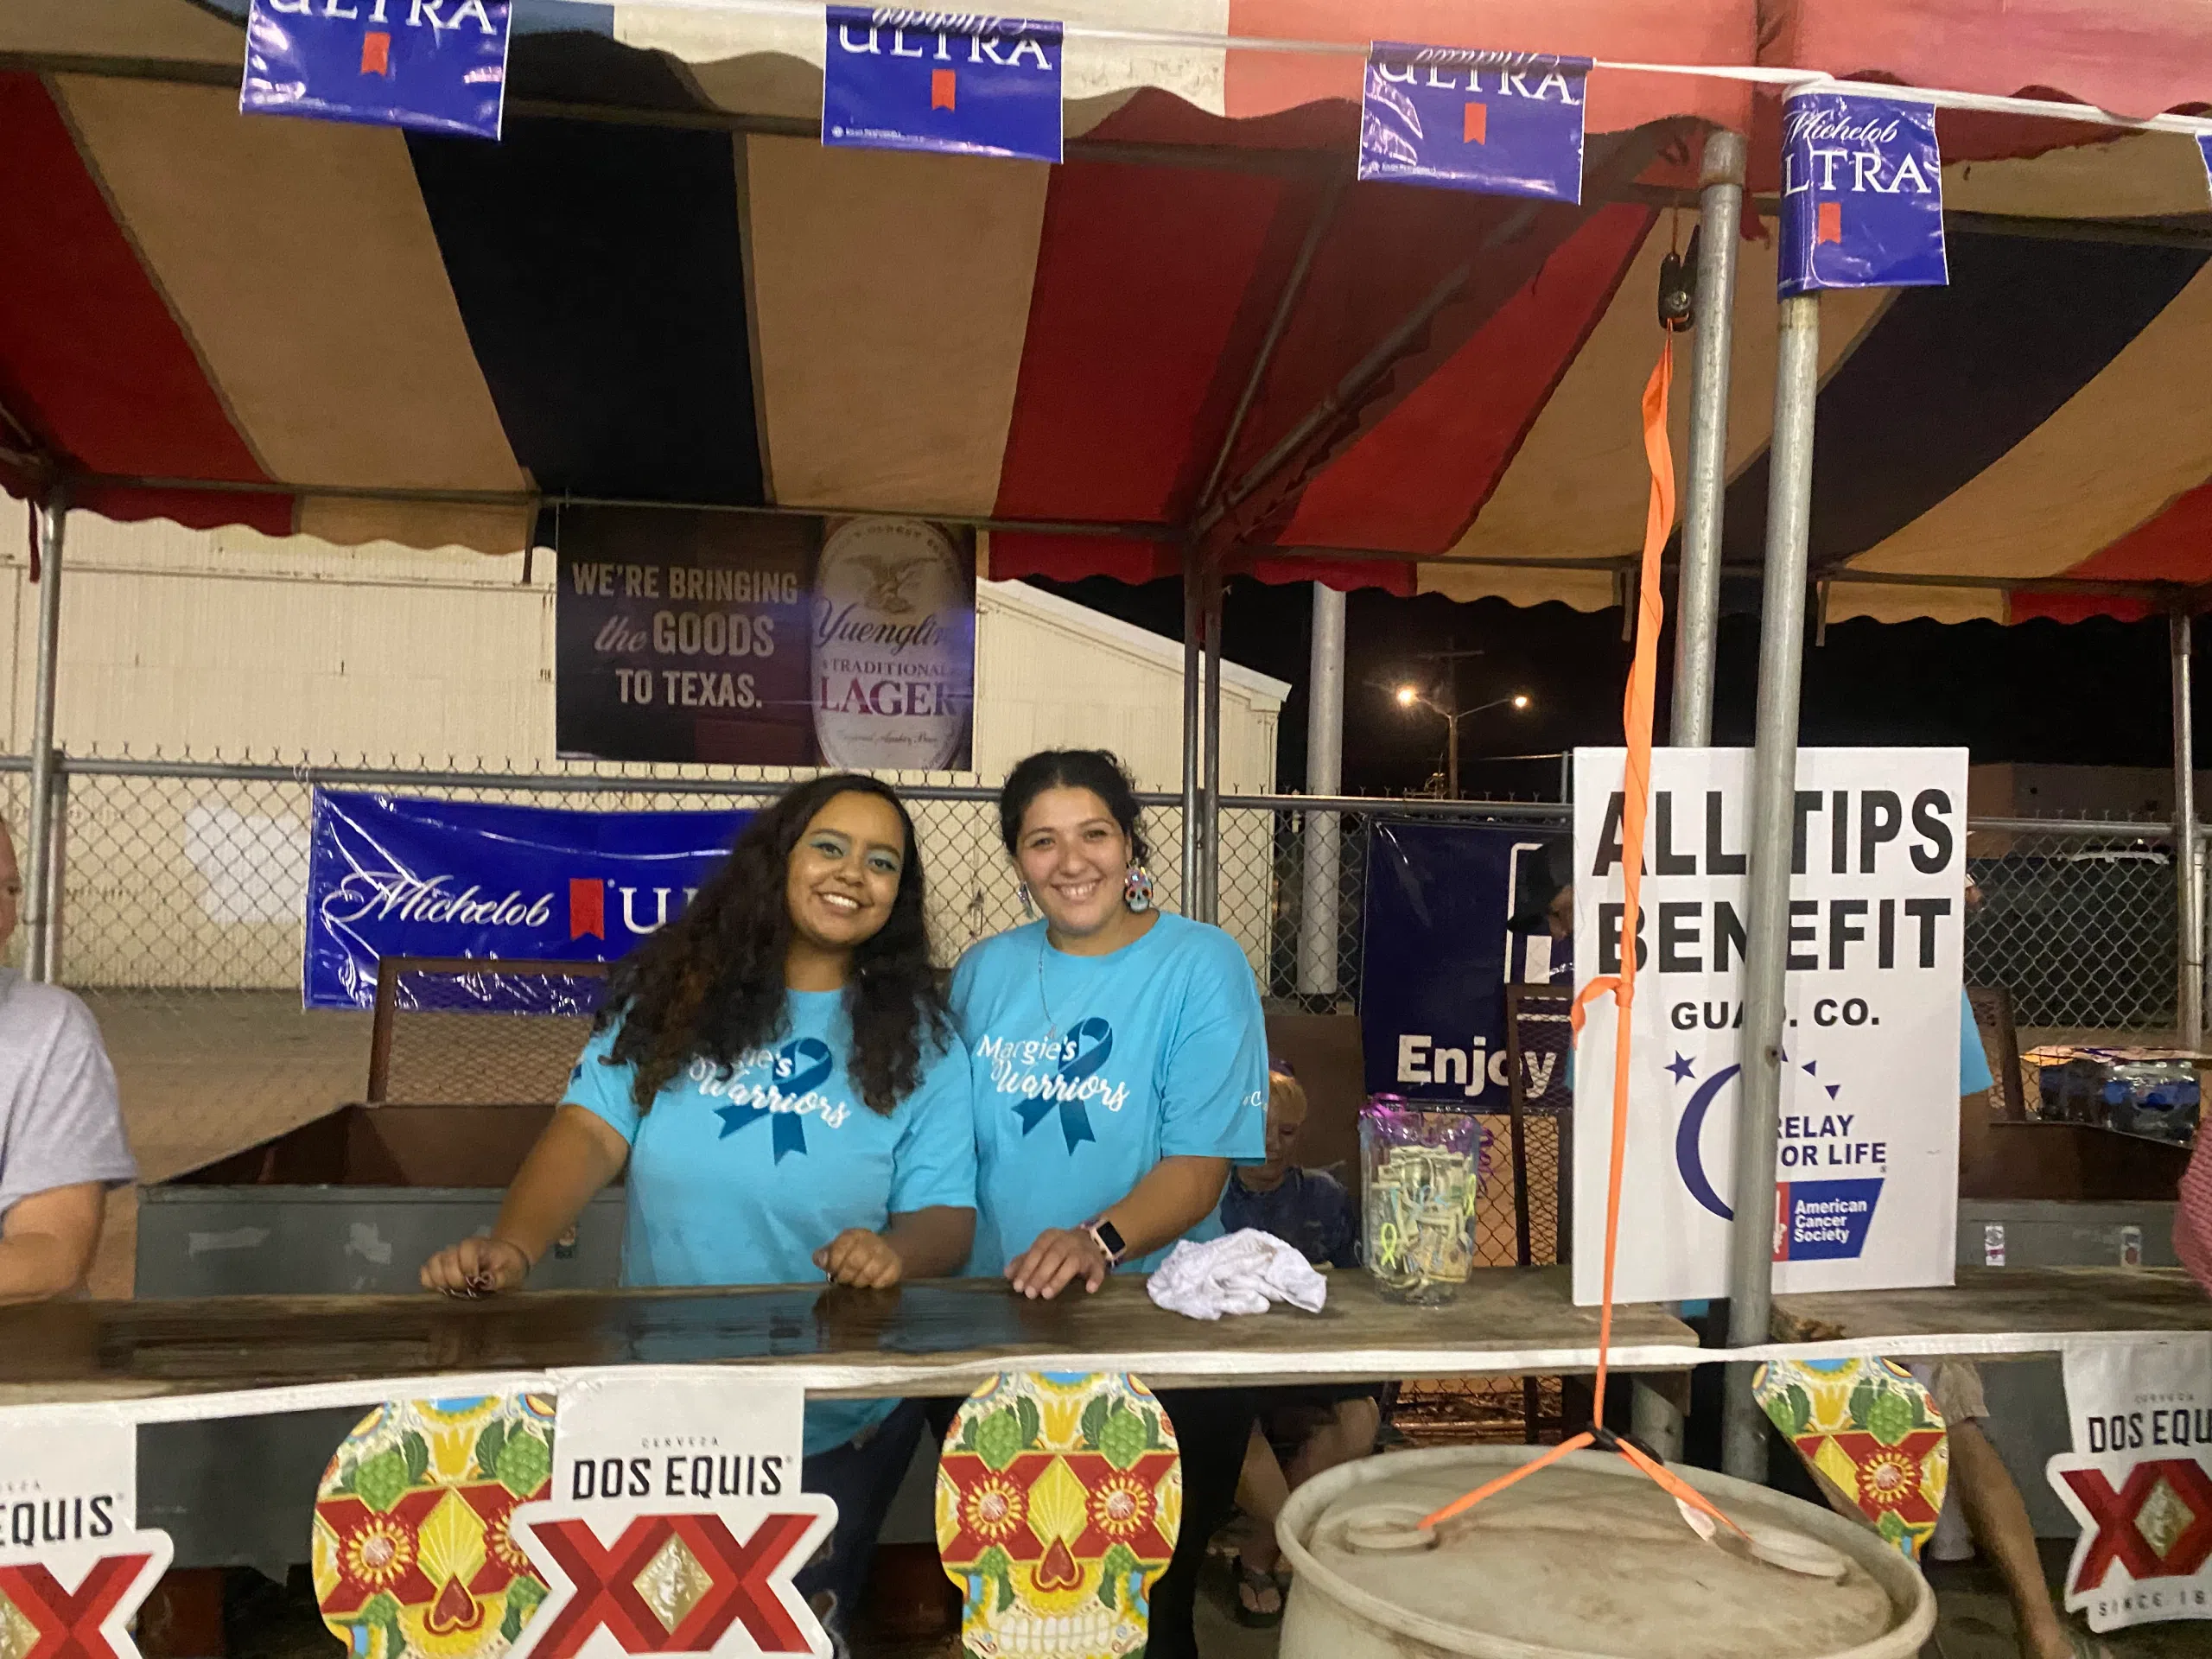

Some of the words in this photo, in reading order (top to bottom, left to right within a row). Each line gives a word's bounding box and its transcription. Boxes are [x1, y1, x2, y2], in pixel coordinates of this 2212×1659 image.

[1783, 108, 1901, 147] Michelob
[571, 562, 660, 599] WE'RE
[668, 566, 798, 605] BRINGING
[594, 613, 648, 653] the
[652, 609, 775, 658] GOODS
[614, 667, 653, 705] TO
[661, 670, 763, 709] TEXAS.
[1592, 790, 1747, 877] ALL
[1792, 788, 1954, 874] TIPS
[321, 870, 555, 928] Michelob
[1598, 898, 1952, 975] BENEFIT
[1814, 997, 1880, 1027] CO.
[976, 1033, 1078, 1065] Margie's
[1396, 1034, 1557, 1099] Enjoy
[689, 1052, 851, 1129] Warriors
[990, 1056, 1131, 1113] Warriors
[1827, 1142, 1886, 1166] LIFE
[1795, 1198, 1868, 1215] American
[1795, 1215, 1848, 1229] Cancer
[1794, 1227, 1851, 1244] Society
[2088, 1412, 2144, 1453] DOS
[572, 1457, 652, 1501] DOS
[665, 1454, 783, 1499] EQUIS
[2098, 1591, 2163, 1617] SINCE
